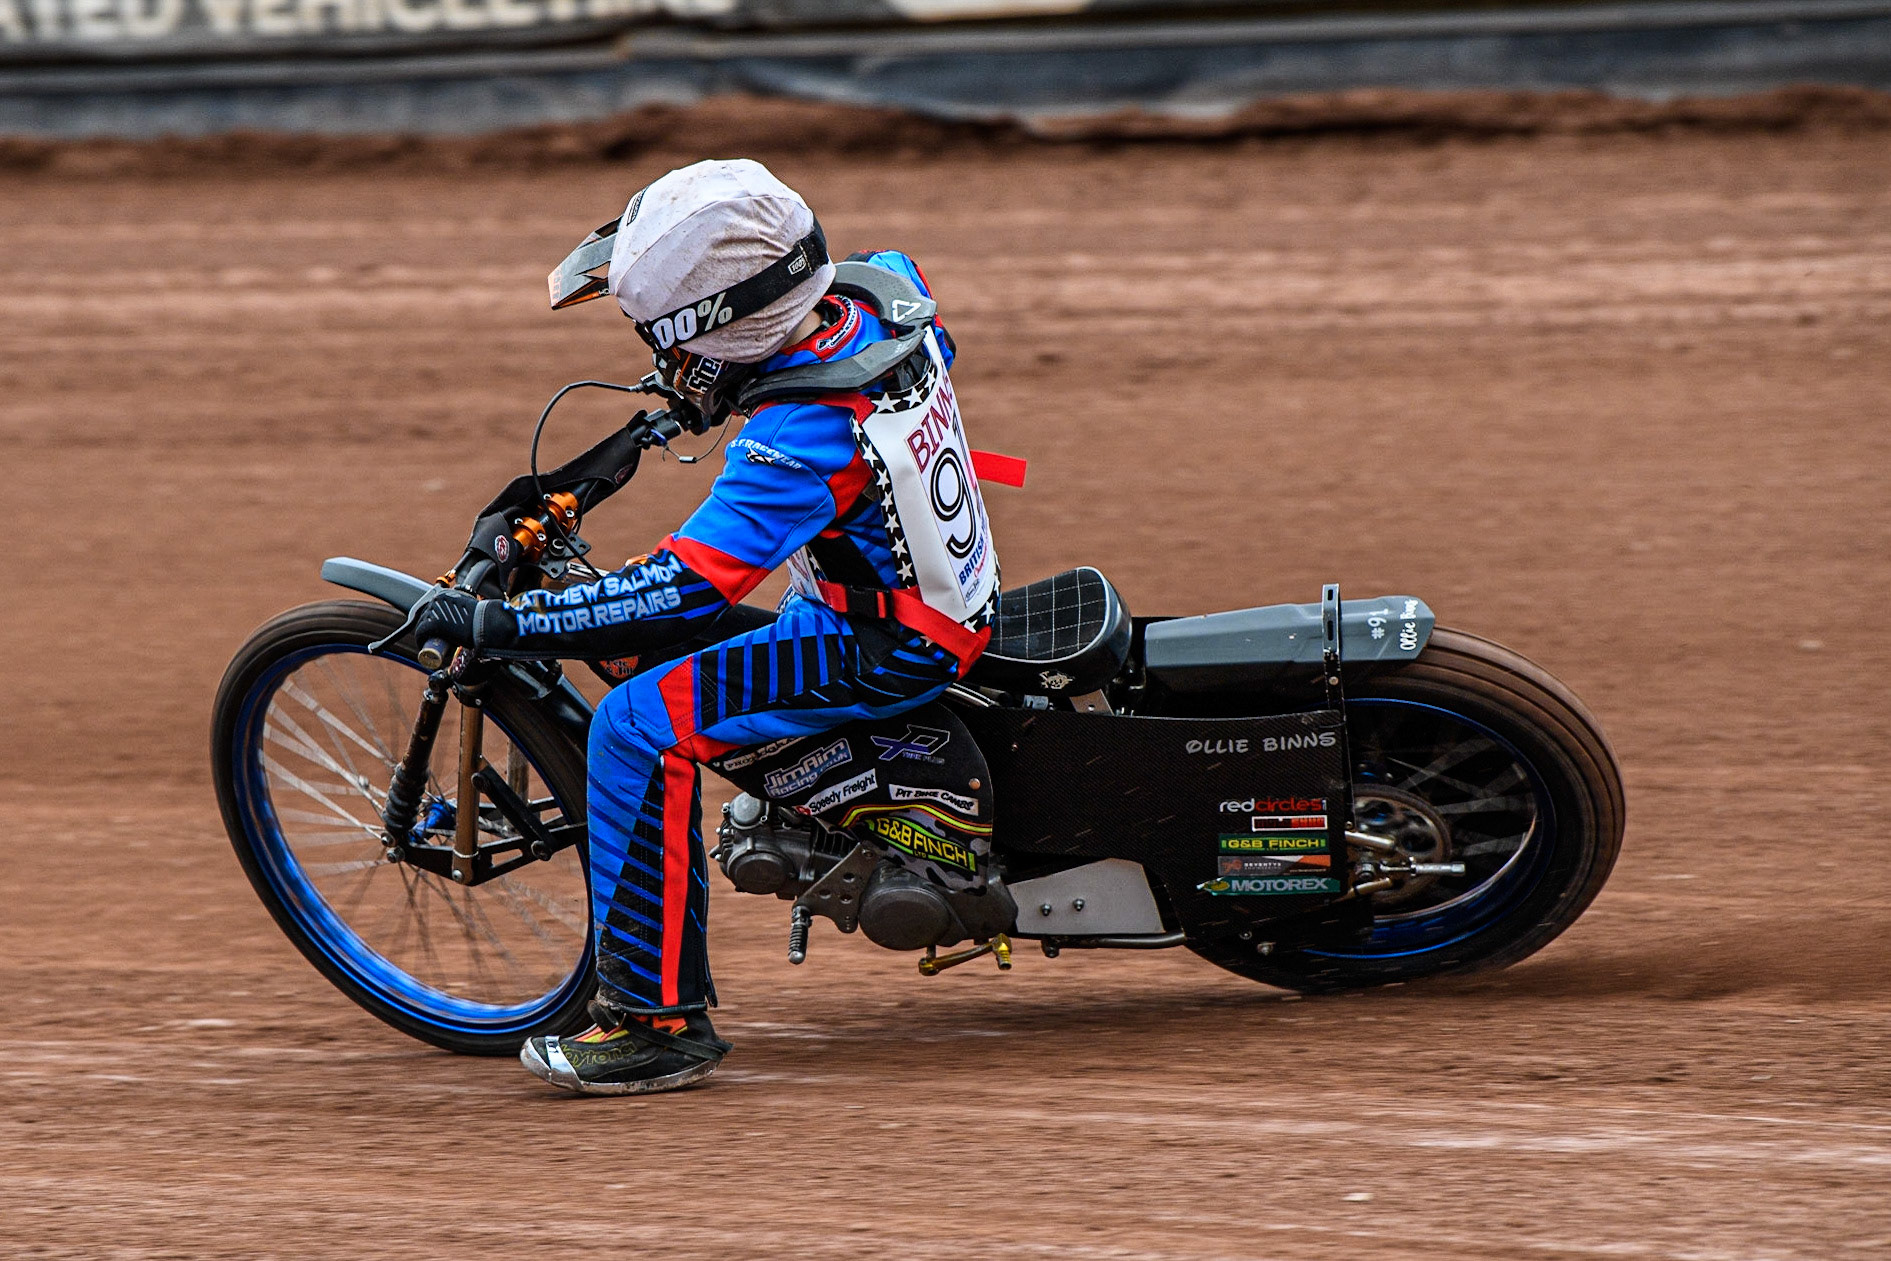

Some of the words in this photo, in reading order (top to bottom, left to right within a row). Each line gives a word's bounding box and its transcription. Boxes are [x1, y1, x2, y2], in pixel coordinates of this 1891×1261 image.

[907, 377, 954, 474] BINN
[603, 554, 682, 597] SALMON
[517, 608, 592, 636] MOTOR
[594, 587, 682, 627] REPAIRS
[1400, 621, 1417, 651] Ollie
[1185, 739, 1249, 754] OLLIE
[1262, 731, 1337, 751] BINNS
[809, 790, 841, 812] Speedy
[842, 774, 876, 799] Freight
[895, 788, 912, 798] PIT
[877, 817, 912, 846] G&B
[914, 832, 968, 867] FINCH
[1228, 839, 1263, 848] G&B
[1269, 839, 1319, 848] FINCH
[1231, 878, 1328, 892] MOTOREX
